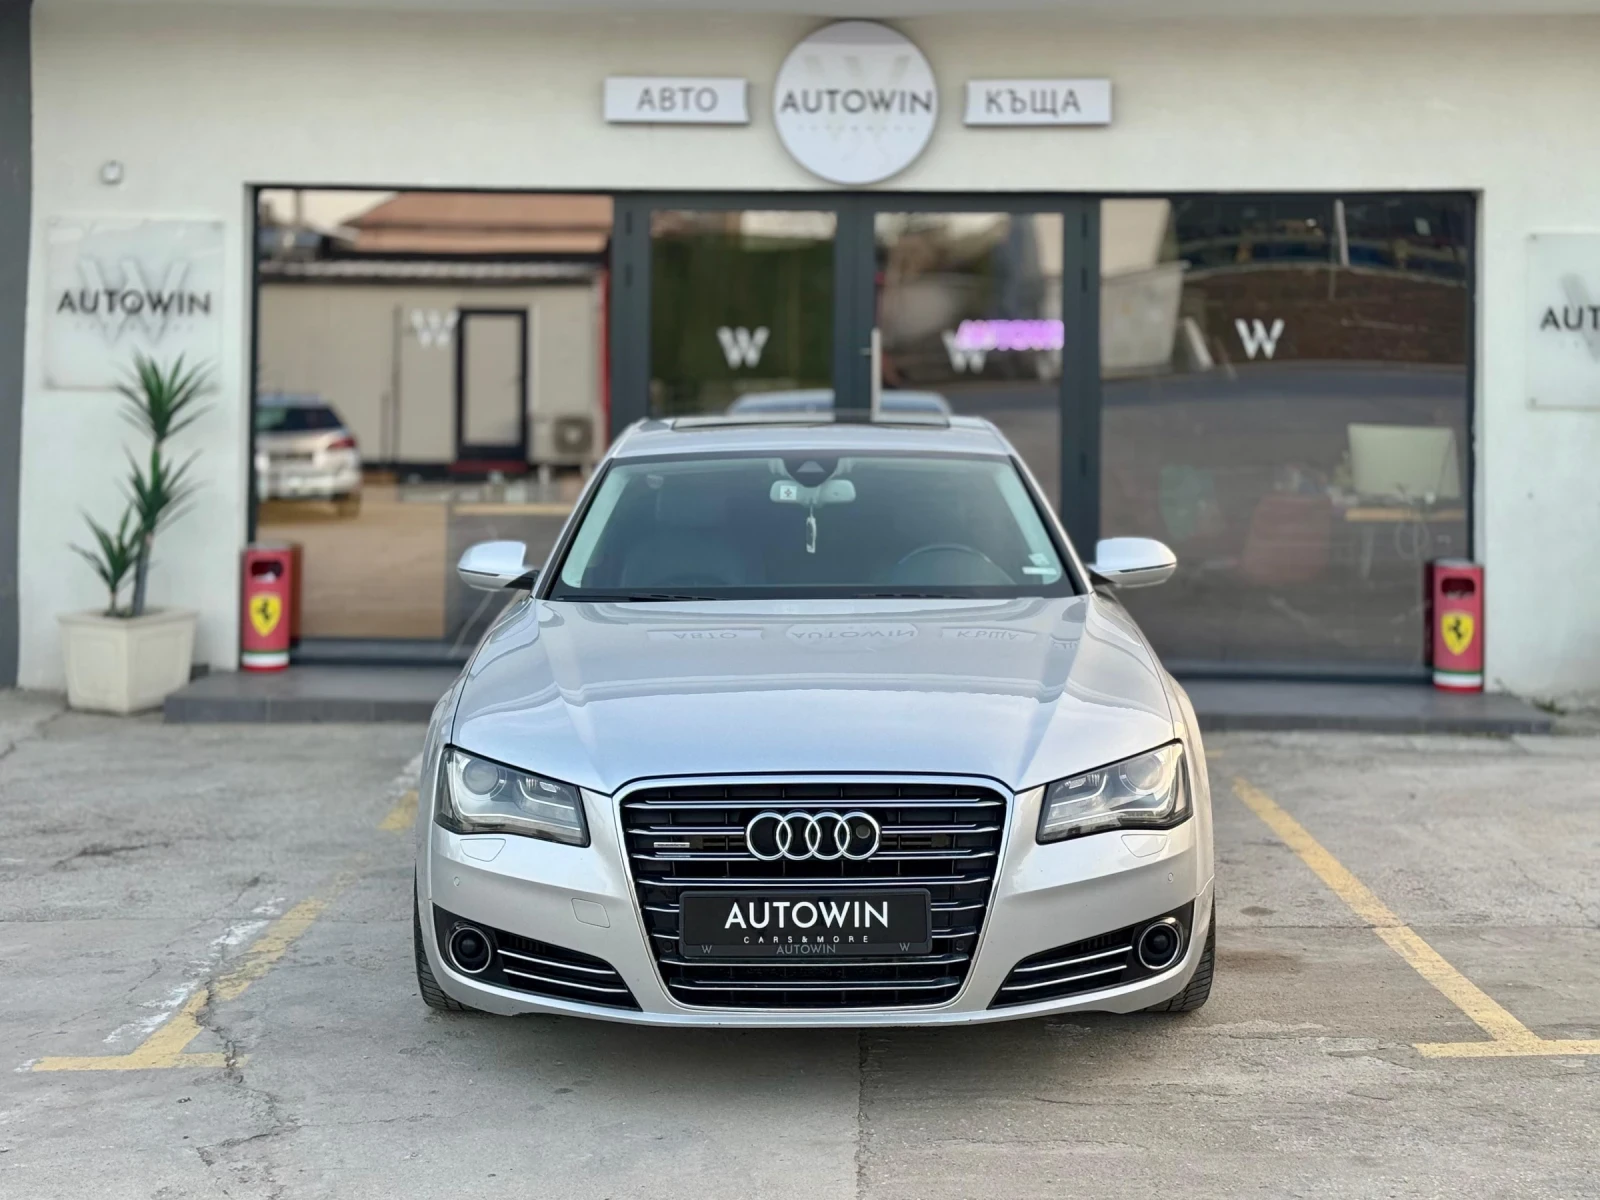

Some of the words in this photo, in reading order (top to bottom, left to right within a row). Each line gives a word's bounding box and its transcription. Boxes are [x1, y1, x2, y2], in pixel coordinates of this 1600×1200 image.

[636, 86, 719, 112] АВТО
[780, 88, 933, 114] AUTOWIN
[985, 88, 1082, 118] КЪЩА
[56, 290, 212, 315] AUTOWIN
[717, 326, 770, 369] W
[1234, 318, 1285, 361] W
[724, 901, 888, 929] AUTOWIN
[701, 944, 712, 955] W
[776, 944, 836, 955] AUTOWIN
[899, 942, 910, 952] W
